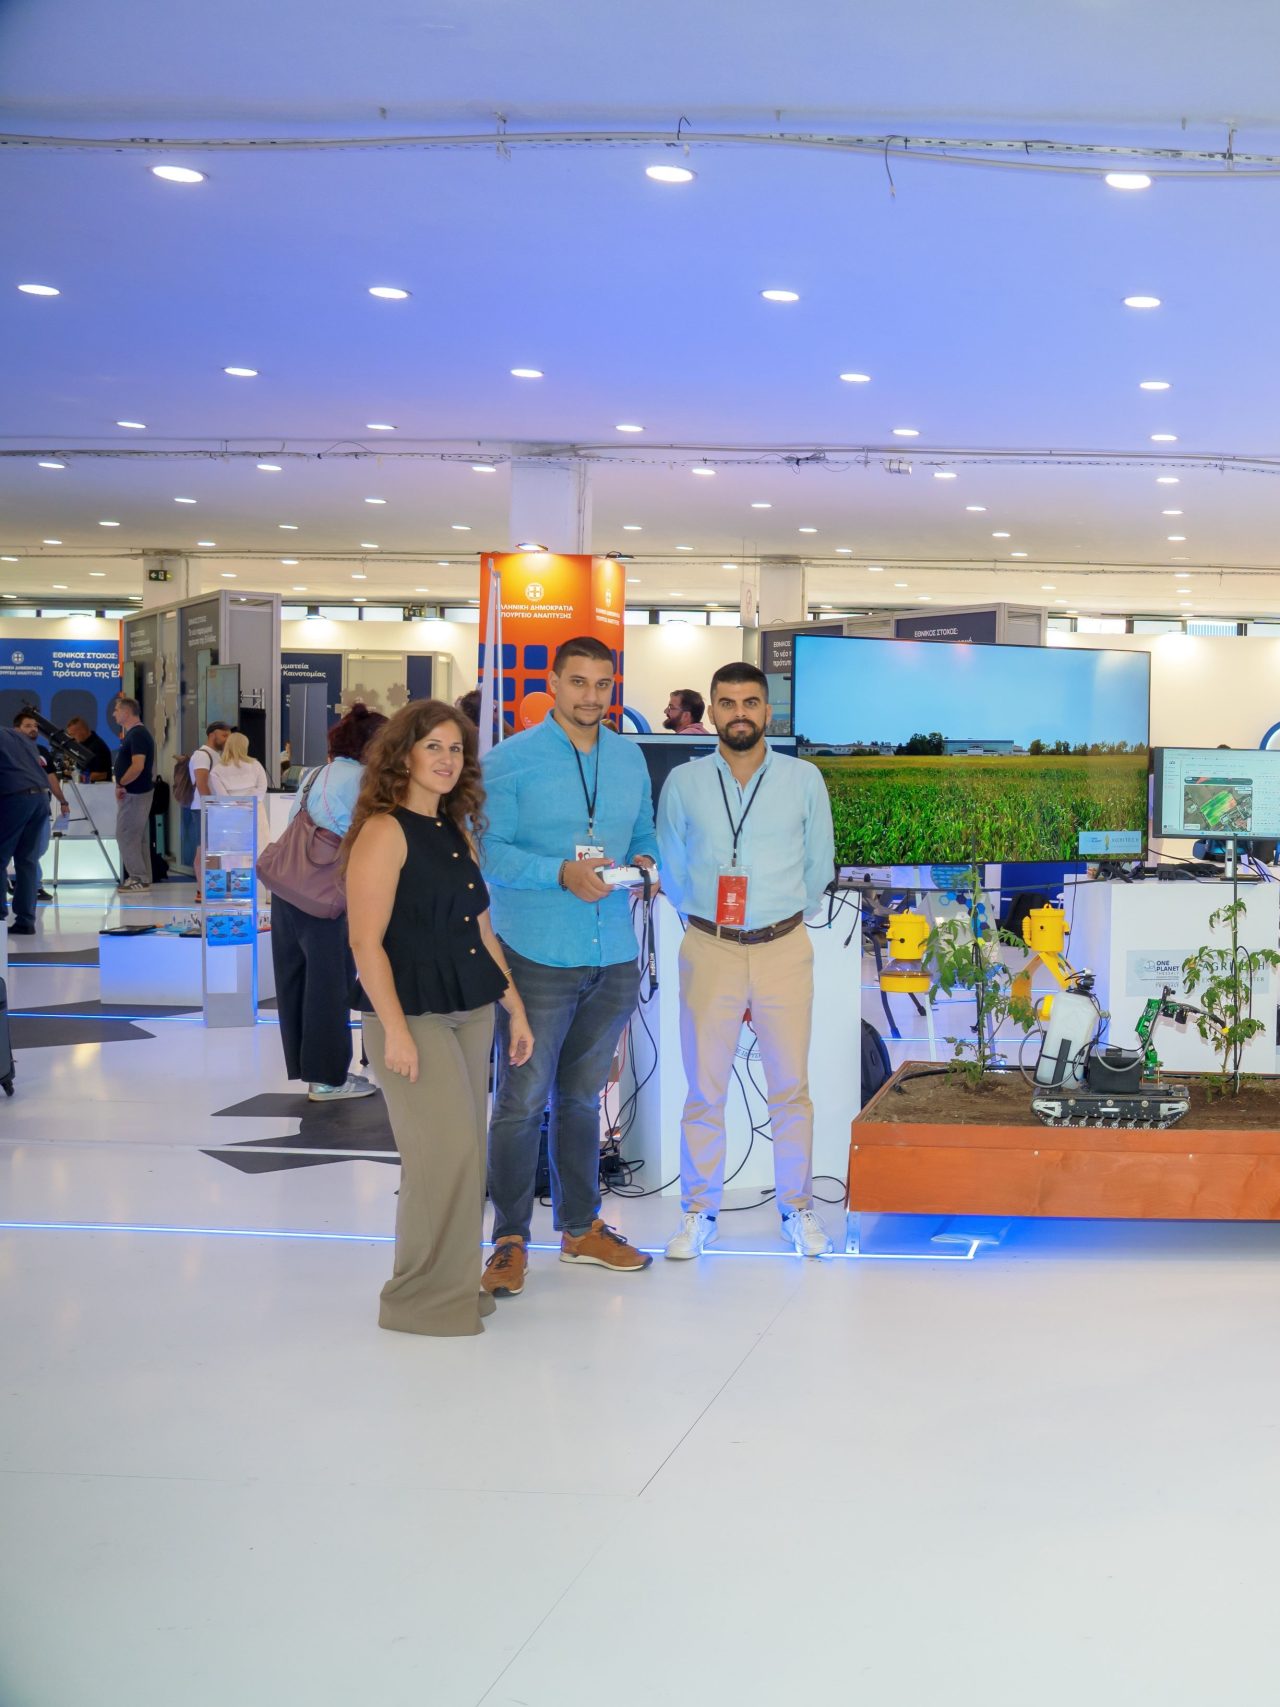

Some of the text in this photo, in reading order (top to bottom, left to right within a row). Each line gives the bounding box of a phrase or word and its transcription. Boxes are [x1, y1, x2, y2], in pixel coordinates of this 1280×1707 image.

[530, 604, 573, 612] ΔΗΜΟΚΡΑΤΙΑ
[53, 660, 63, 669] Το
[65, 660, 81, 669] νέο
[53, 669, 92, 678] πρότυπο
[93, 671, 109, 679] της
